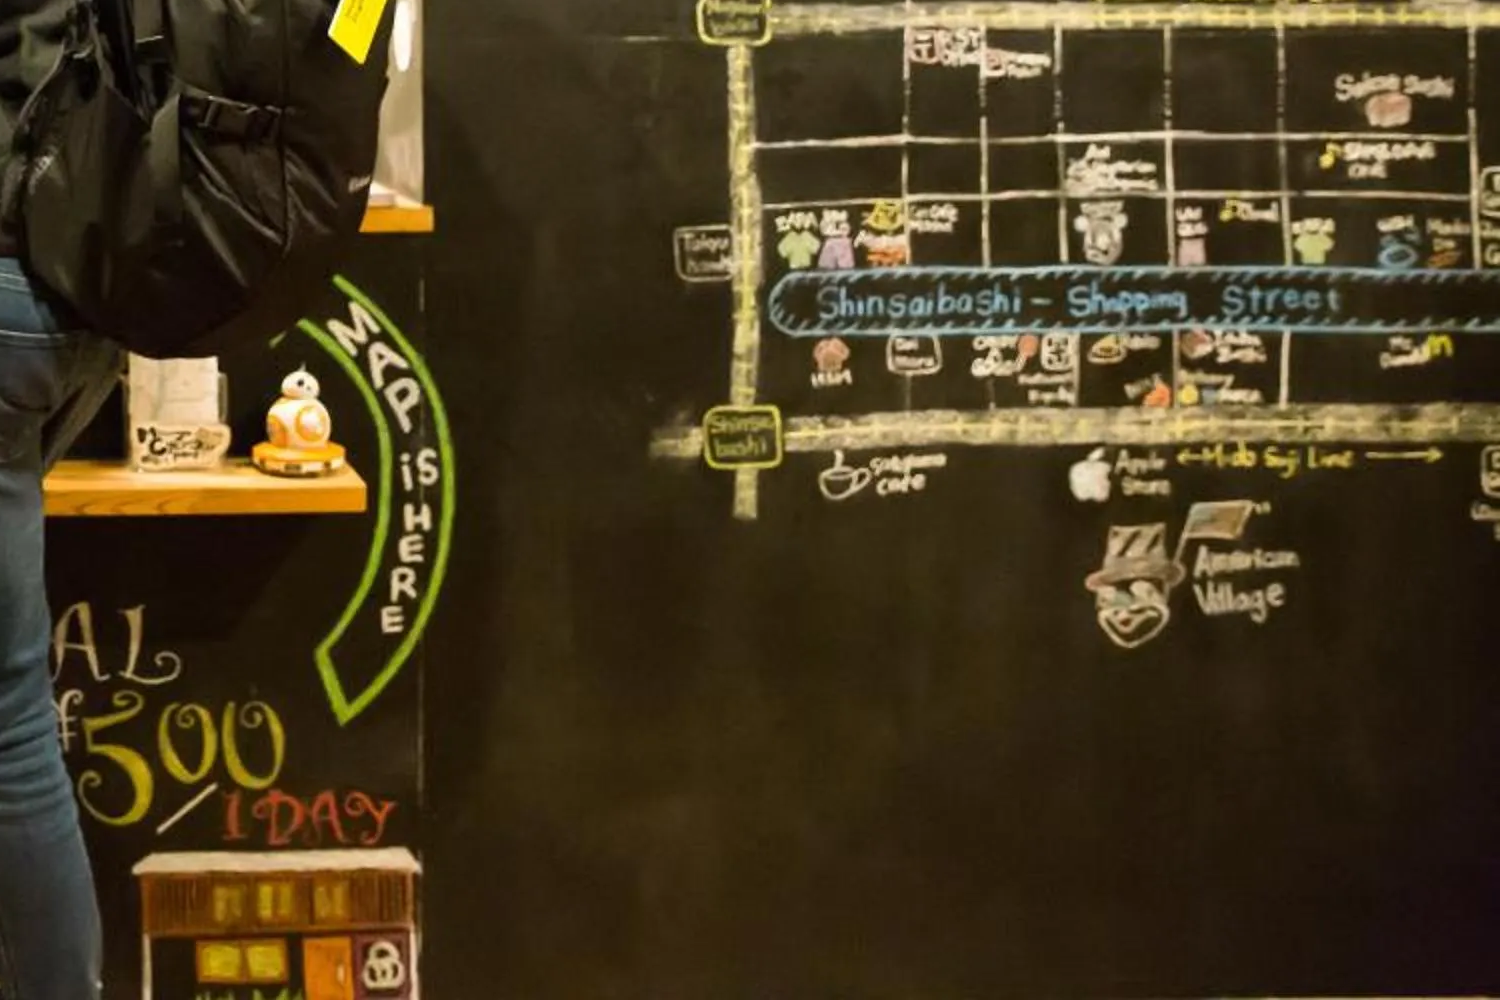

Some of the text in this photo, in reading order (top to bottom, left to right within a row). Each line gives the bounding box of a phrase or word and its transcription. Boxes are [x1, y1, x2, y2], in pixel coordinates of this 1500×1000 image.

[816, 284, 1022, 321] Shinsaibashi
[1221, 282, 1342, 318] Street
[327, 300, 421, 434] MAP
[380, 503, 432, 635] HERE
[1194, 582, 1286, 624] Village
